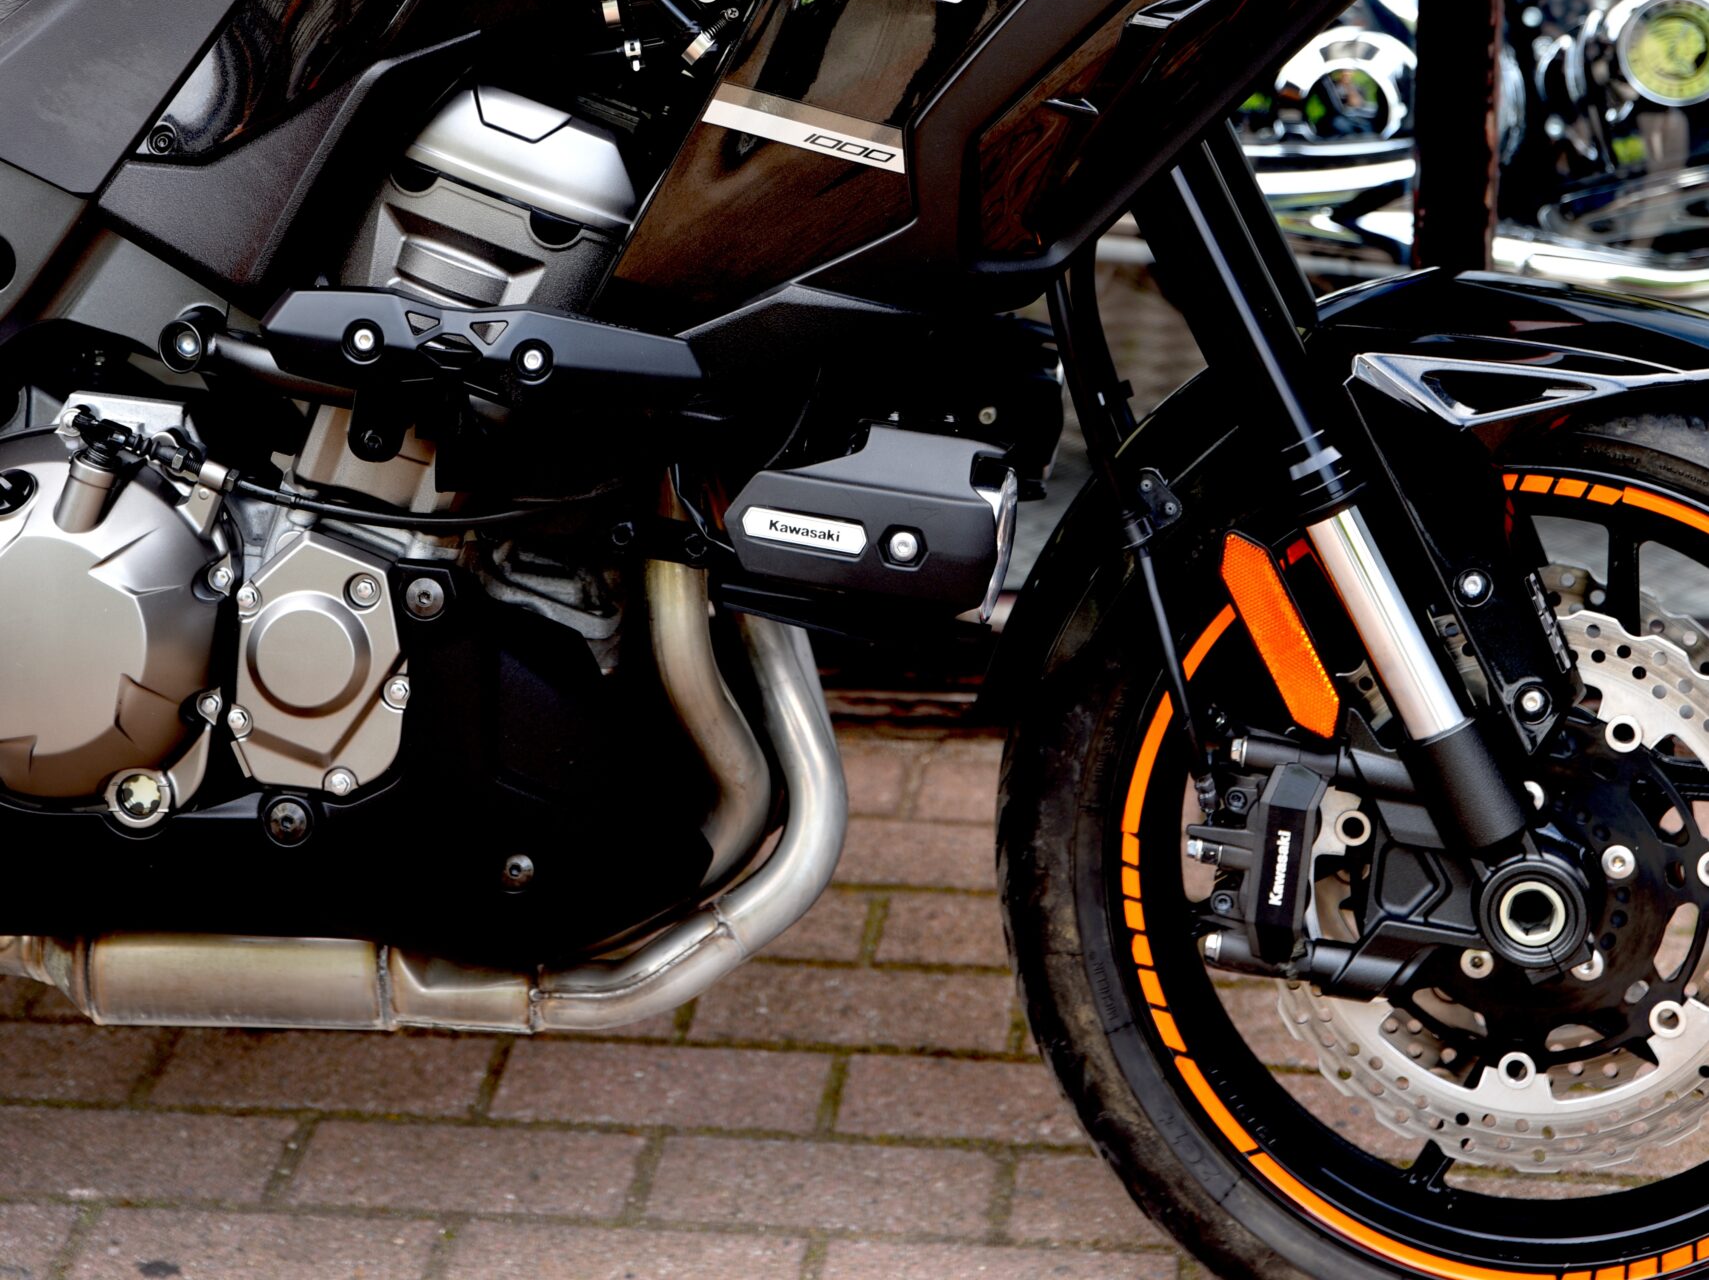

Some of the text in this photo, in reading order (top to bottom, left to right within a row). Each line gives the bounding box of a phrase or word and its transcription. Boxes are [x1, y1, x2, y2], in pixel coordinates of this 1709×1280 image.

[803, 133, 896, 163] 1000
[768, 519, 841, 543] Kawasaki
[1268, 829, 1292, 906] Kawasaki
